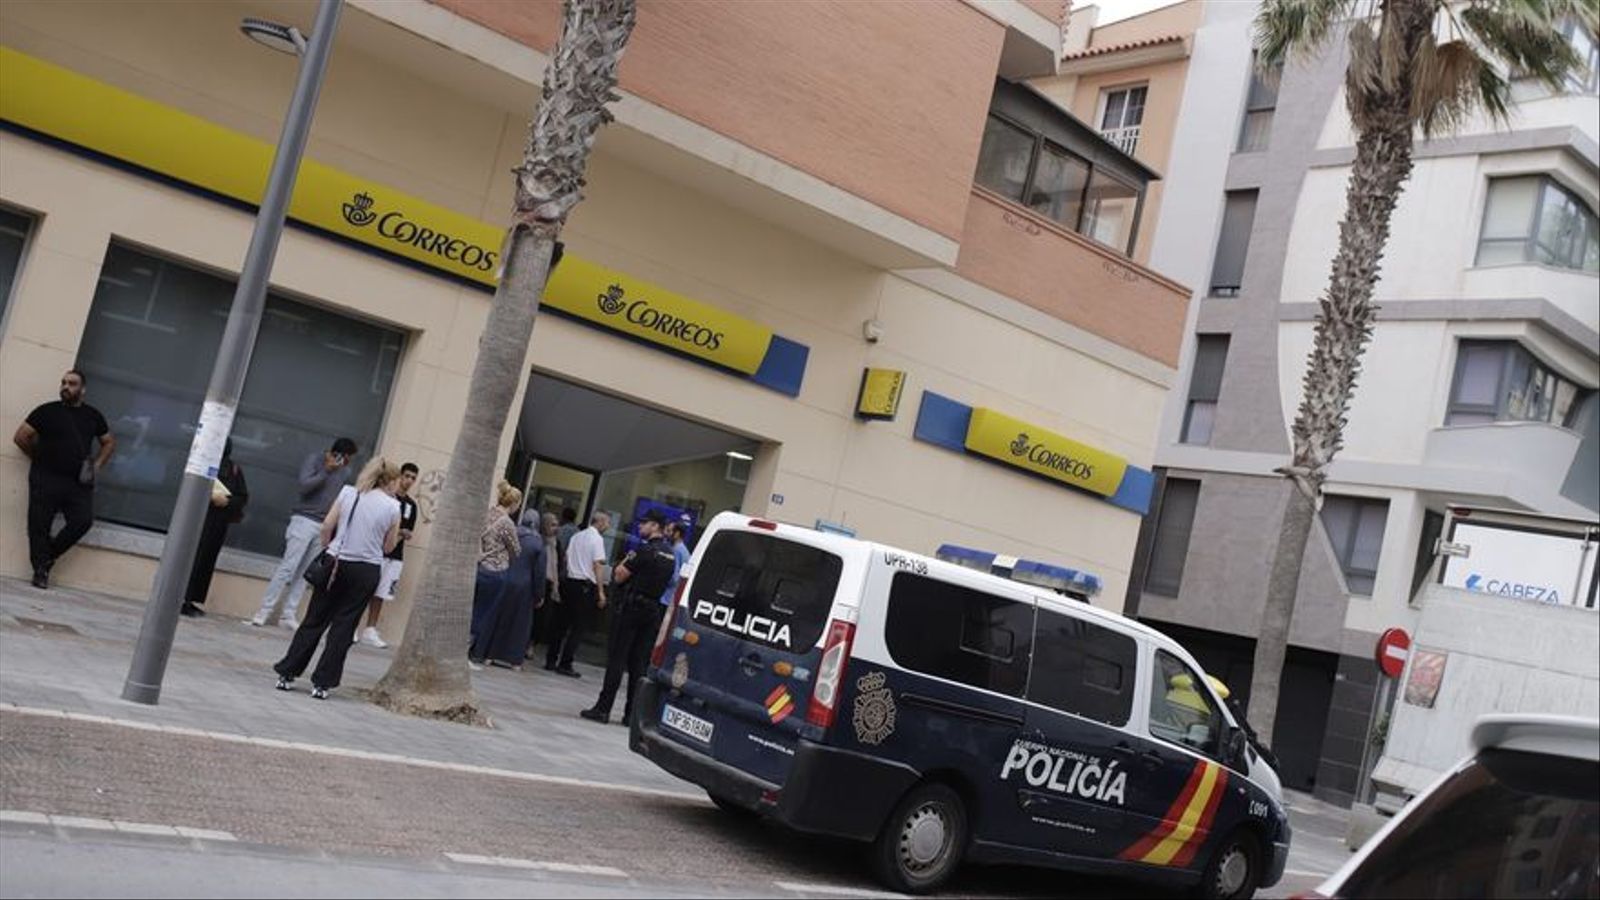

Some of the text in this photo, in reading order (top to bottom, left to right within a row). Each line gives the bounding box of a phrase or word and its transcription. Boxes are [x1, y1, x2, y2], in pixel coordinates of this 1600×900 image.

[378, 212, 498, 271] CORREOS
[627, 300, 724, 350] CORREOS
[1029, 444, 1093, 480] CORREOS
[693, 600, 791, 648] POLICIA
[1001, 743, 1127, 805] POLICÍA
[1014, 739, 1048, 752] CUERPO
[1049, 747, 1087, 763] NACIONAL
